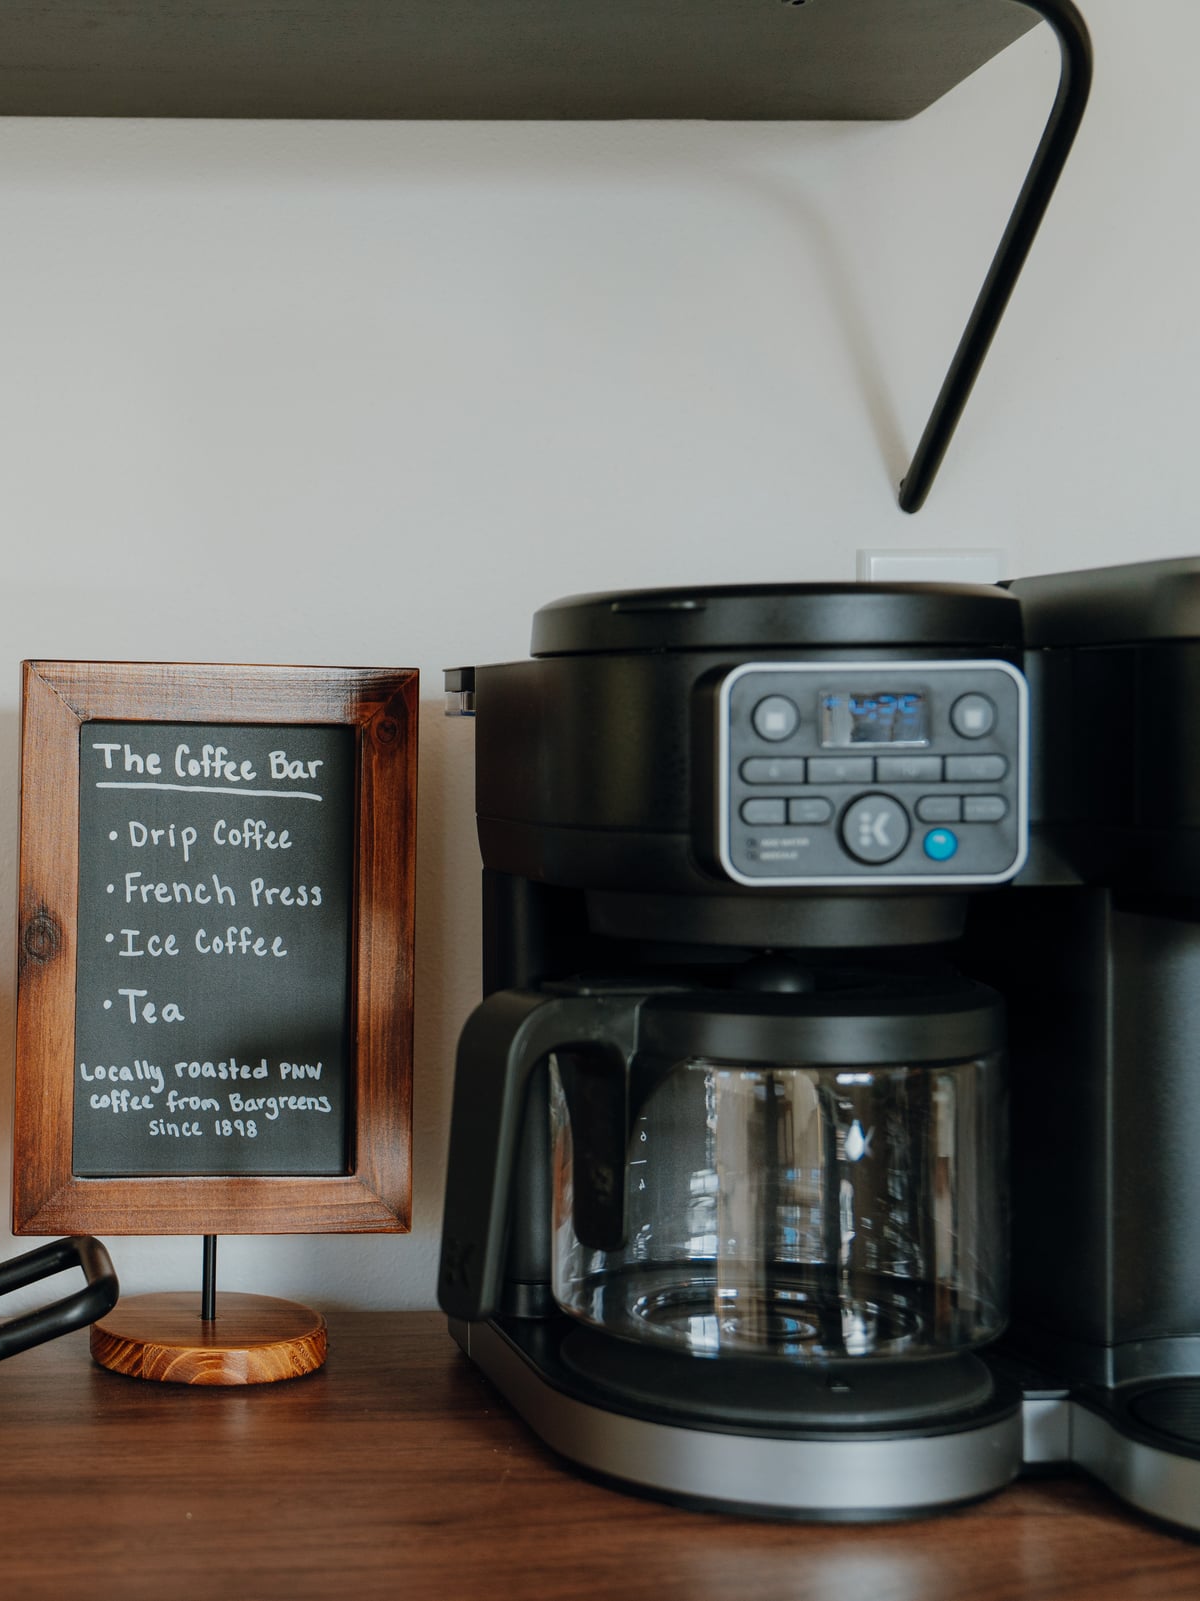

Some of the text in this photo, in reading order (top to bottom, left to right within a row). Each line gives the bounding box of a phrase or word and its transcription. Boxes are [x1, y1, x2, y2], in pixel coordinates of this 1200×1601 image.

[92, 743, 323, 781] The Coffee Bar
[129, 819, 292, 862] Drip Coffee
[125, 872, 321, 906] French Press
[119, 926, 287, 957] Ice Coffee
[118, 989, 185, 1024] Tea
[80, 1059, 322, 1094] Locally roasted PNW
[90, 1089, 331, 1120] coffee from Bargreens
[149, 1119, 257, 1137] since 1898
